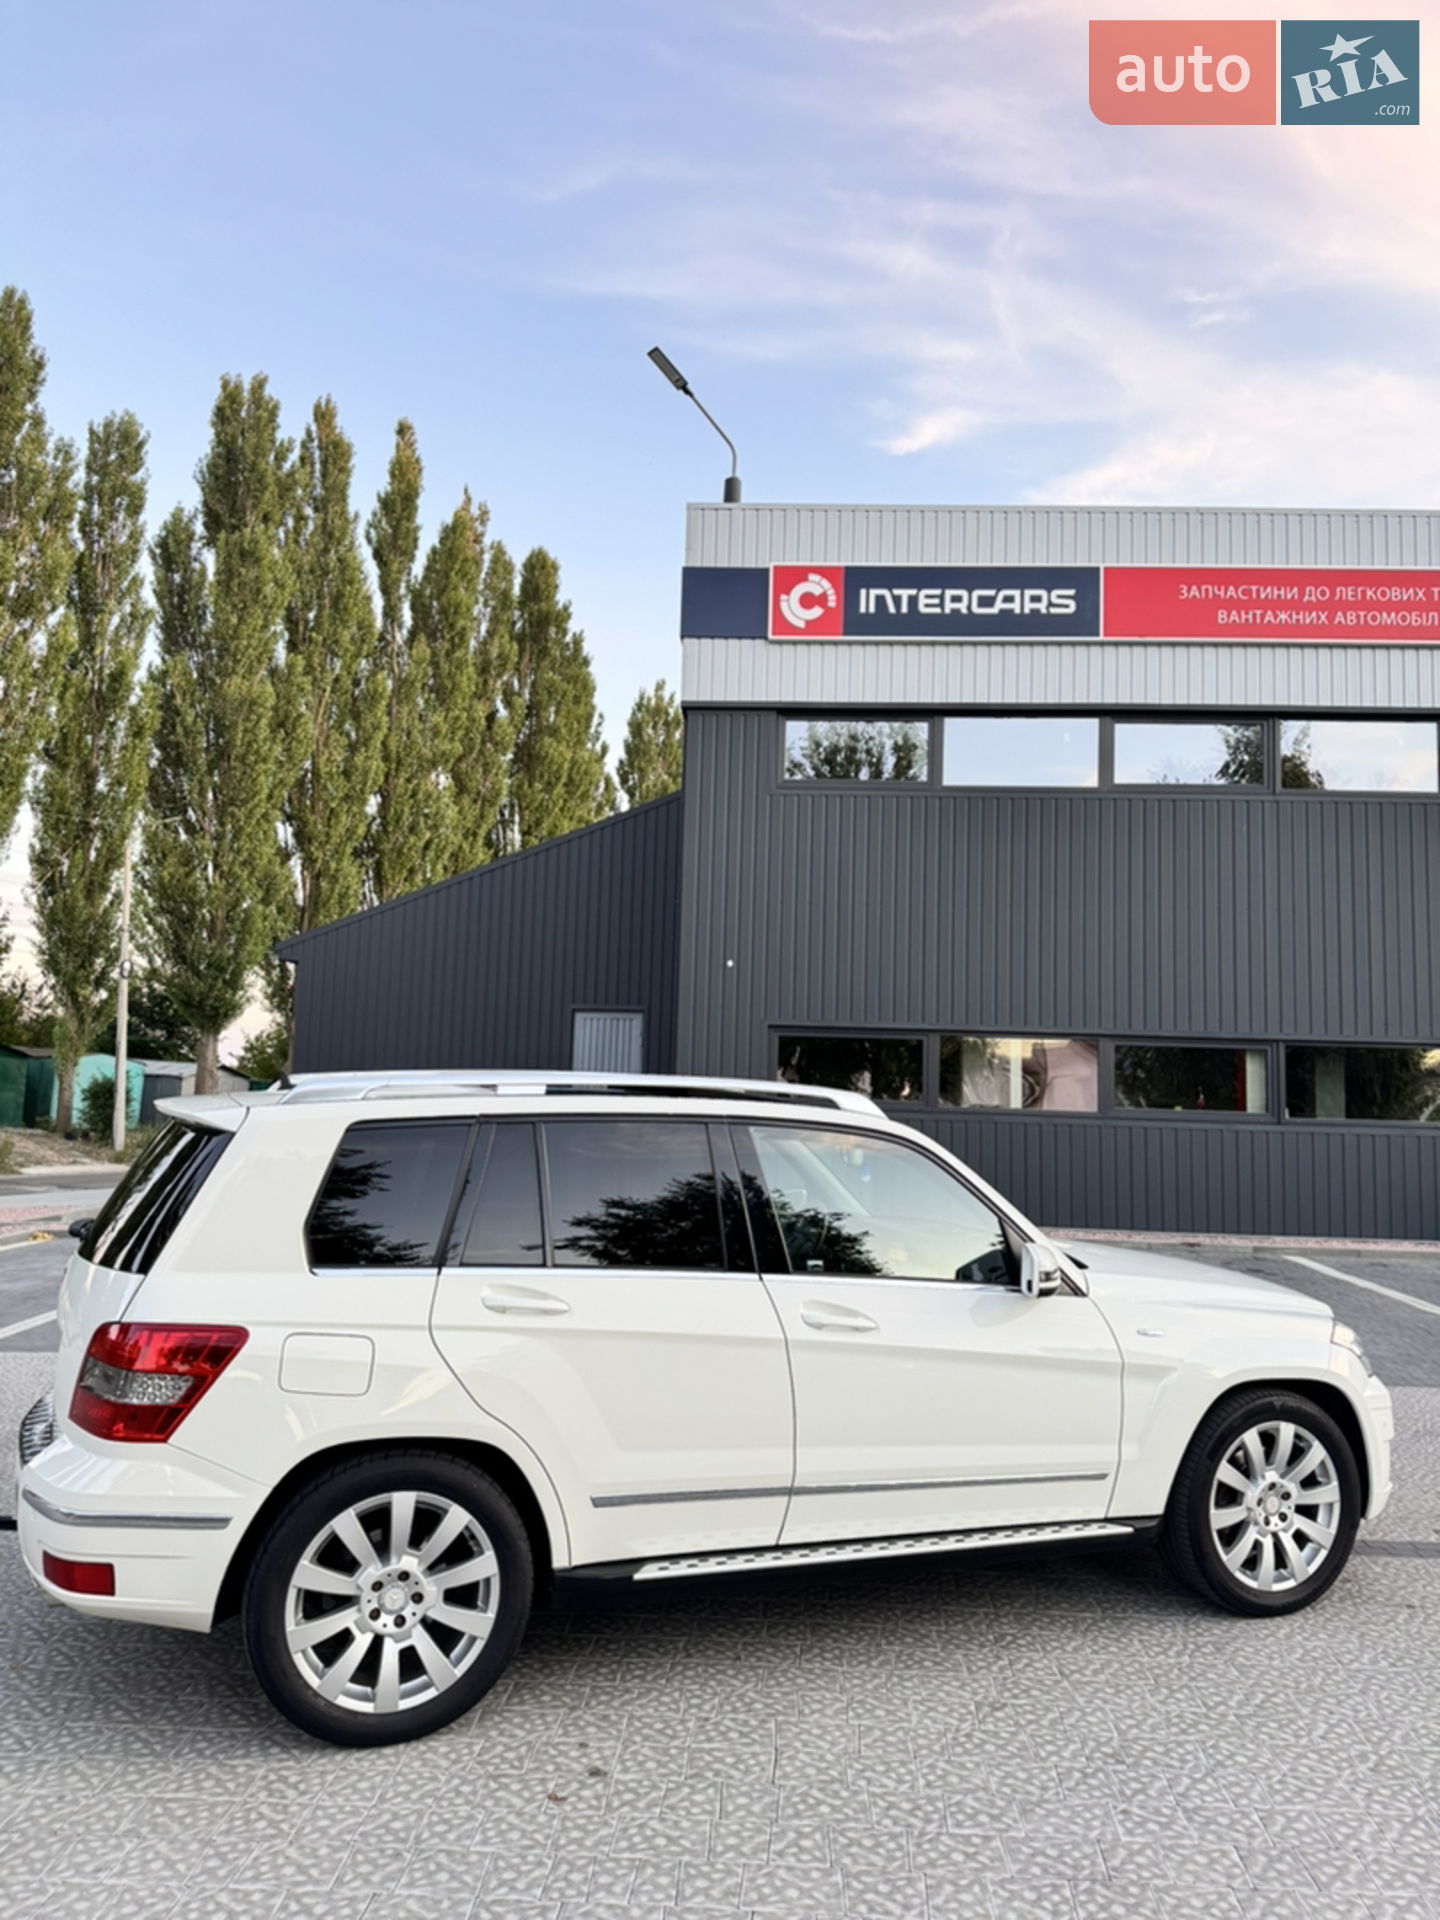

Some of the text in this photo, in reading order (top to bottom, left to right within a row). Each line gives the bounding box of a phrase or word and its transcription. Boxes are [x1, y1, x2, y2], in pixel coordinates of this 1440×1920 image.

[859, 588, 1077, 614] INTERCARS
[1178, 585, 1299, 600] ЗАПЧАСТИНИ
[1302, 586, 1330, 604] ДО
[1333, 586, 1427, 602] ЛЕГКОВИХ
[1217, 609, 1439, 627] ВАНТАЖНИХ АВТОМОБІЛ
